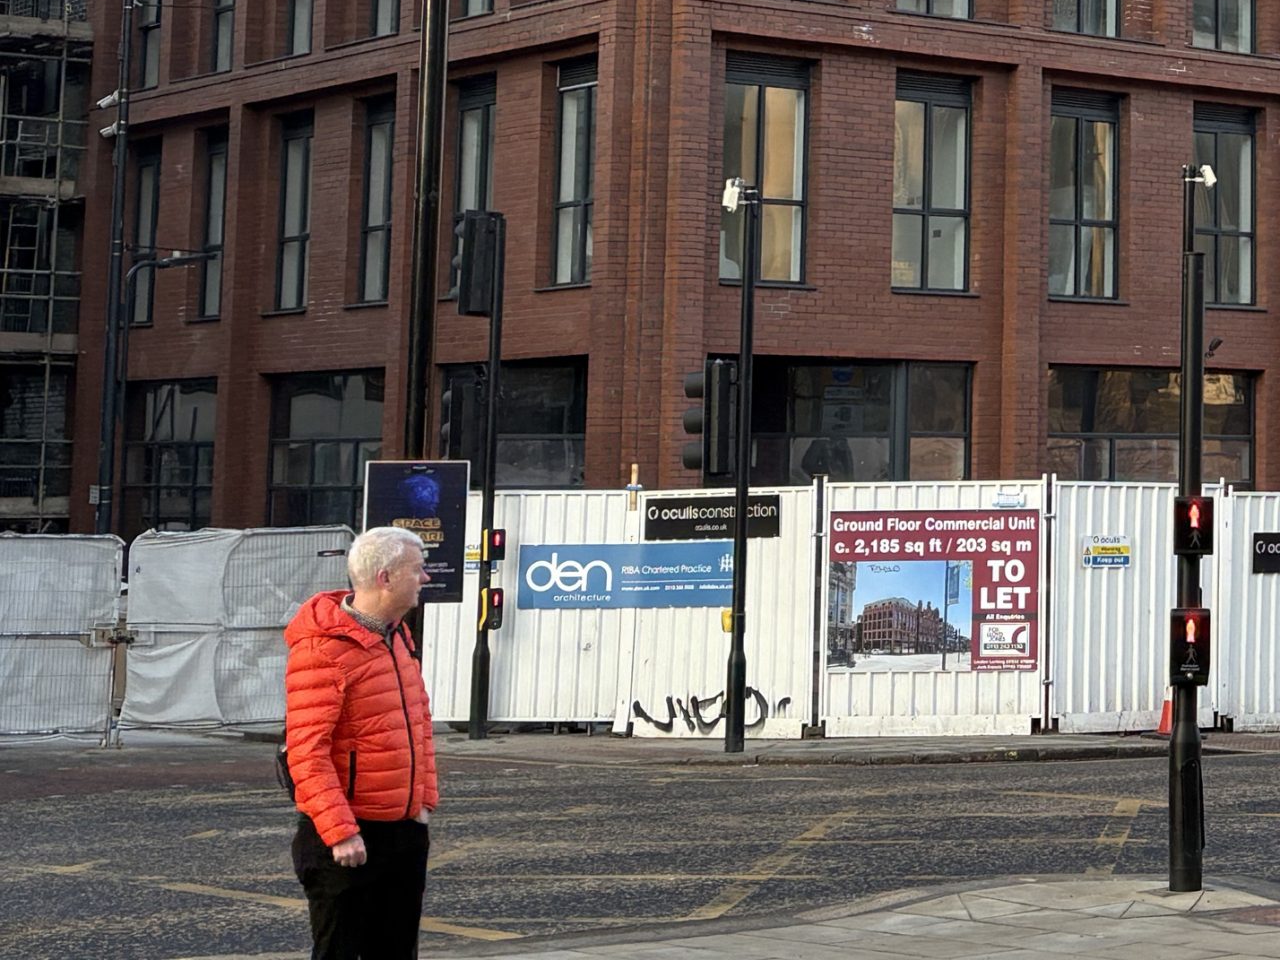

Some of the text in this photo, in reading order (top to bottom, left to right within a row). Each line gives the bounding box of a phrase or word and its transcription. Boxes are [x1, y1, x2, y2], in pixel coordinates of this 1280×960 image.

[833, 516, 1035, 531] Ground Floor Commercial Unit
[835, 538, 1032, 556] c. 2,185 sq ft / 203 sq m
[526, 553, 613, 592] den
[621, 564, 712, 574] RIBA Chartered Practice
[986, 559, 1025, 583] TO
[553, 593, 611, 602] architecture
[980, 586, 1031, 609] LET
